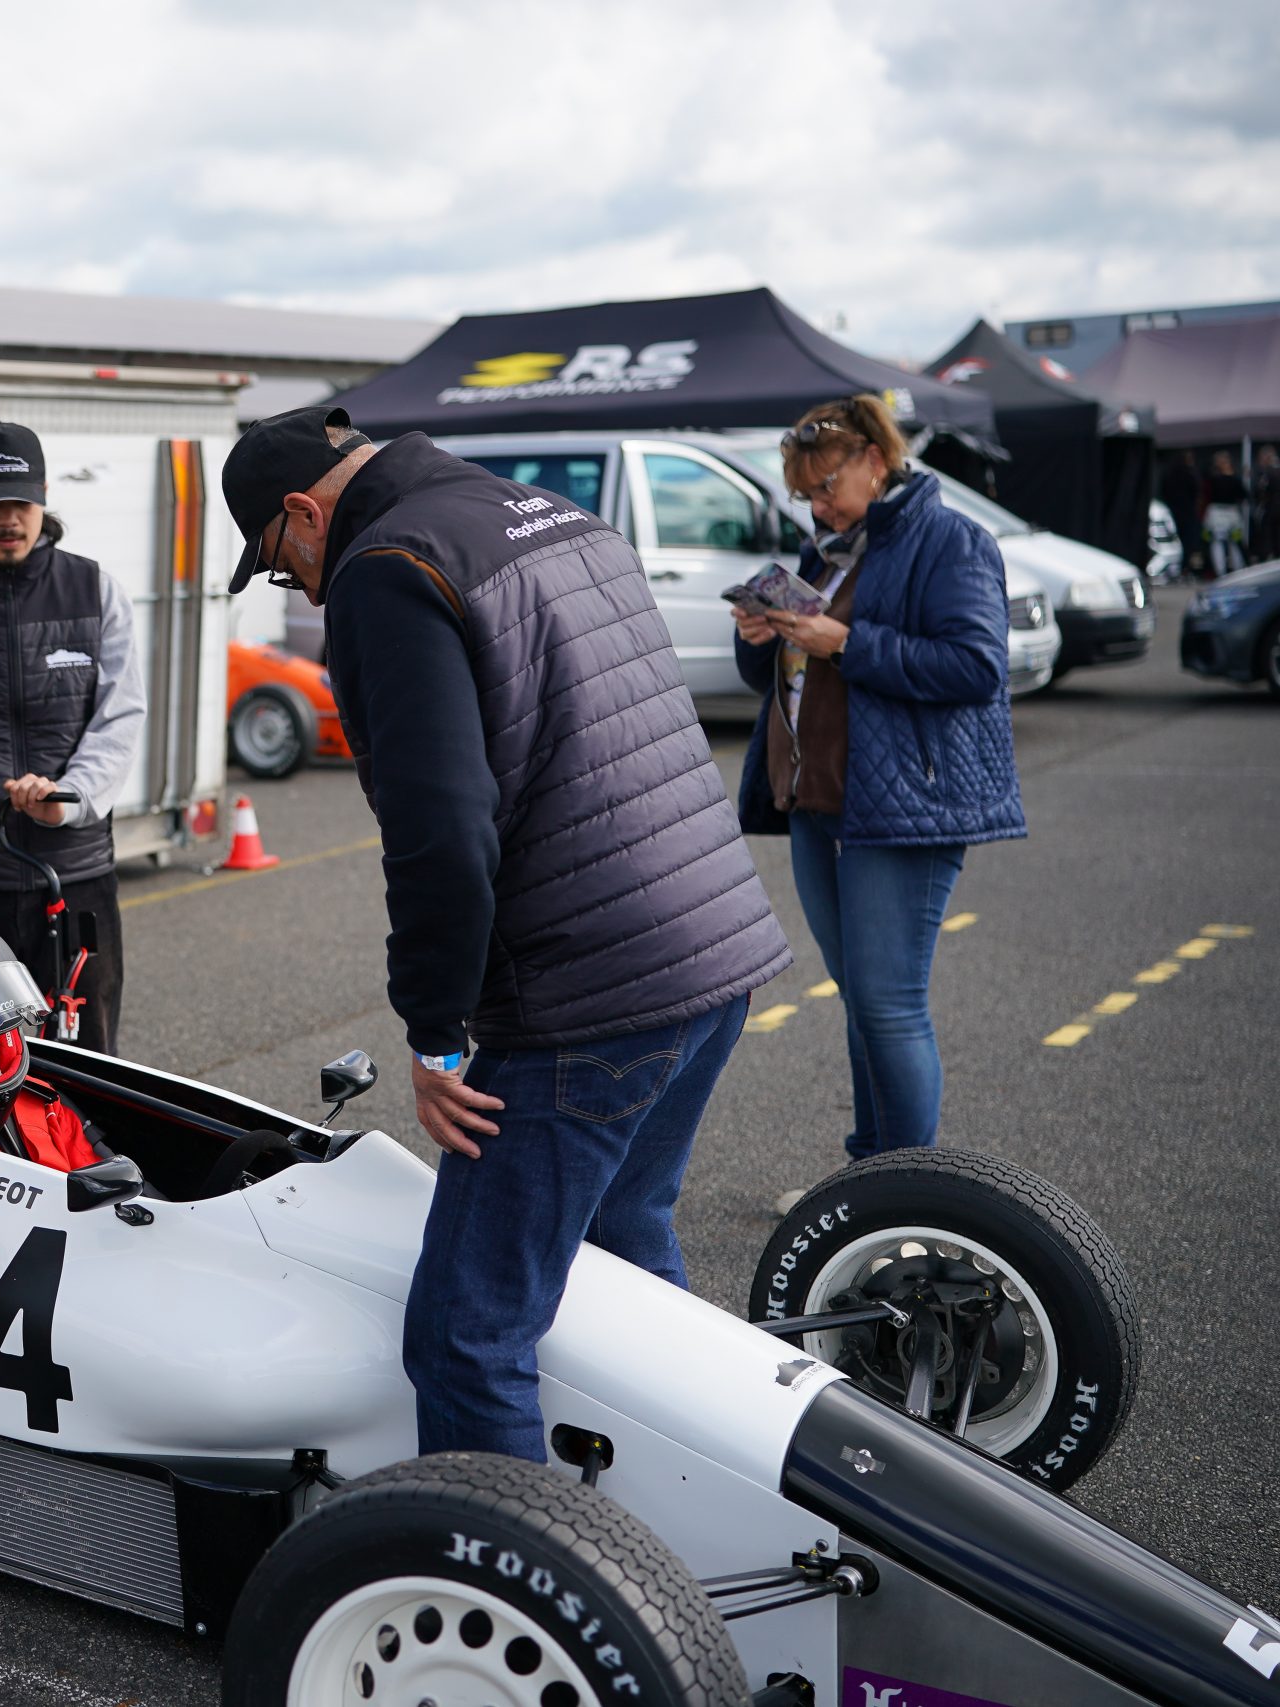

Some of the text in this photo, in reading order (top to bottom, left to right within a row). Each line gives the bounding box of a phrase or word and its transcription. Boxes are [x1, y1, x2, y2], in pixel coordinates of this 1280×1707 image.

[436, 376, 686, 405] PERFORMANCE
[503, 497, 553, 515] Team
[505, 509, 588, 540] Asphalte Racing
[766, 1202, 850, 1320] Hoosier
[444, 1532, 640, 1696] Hoosier
